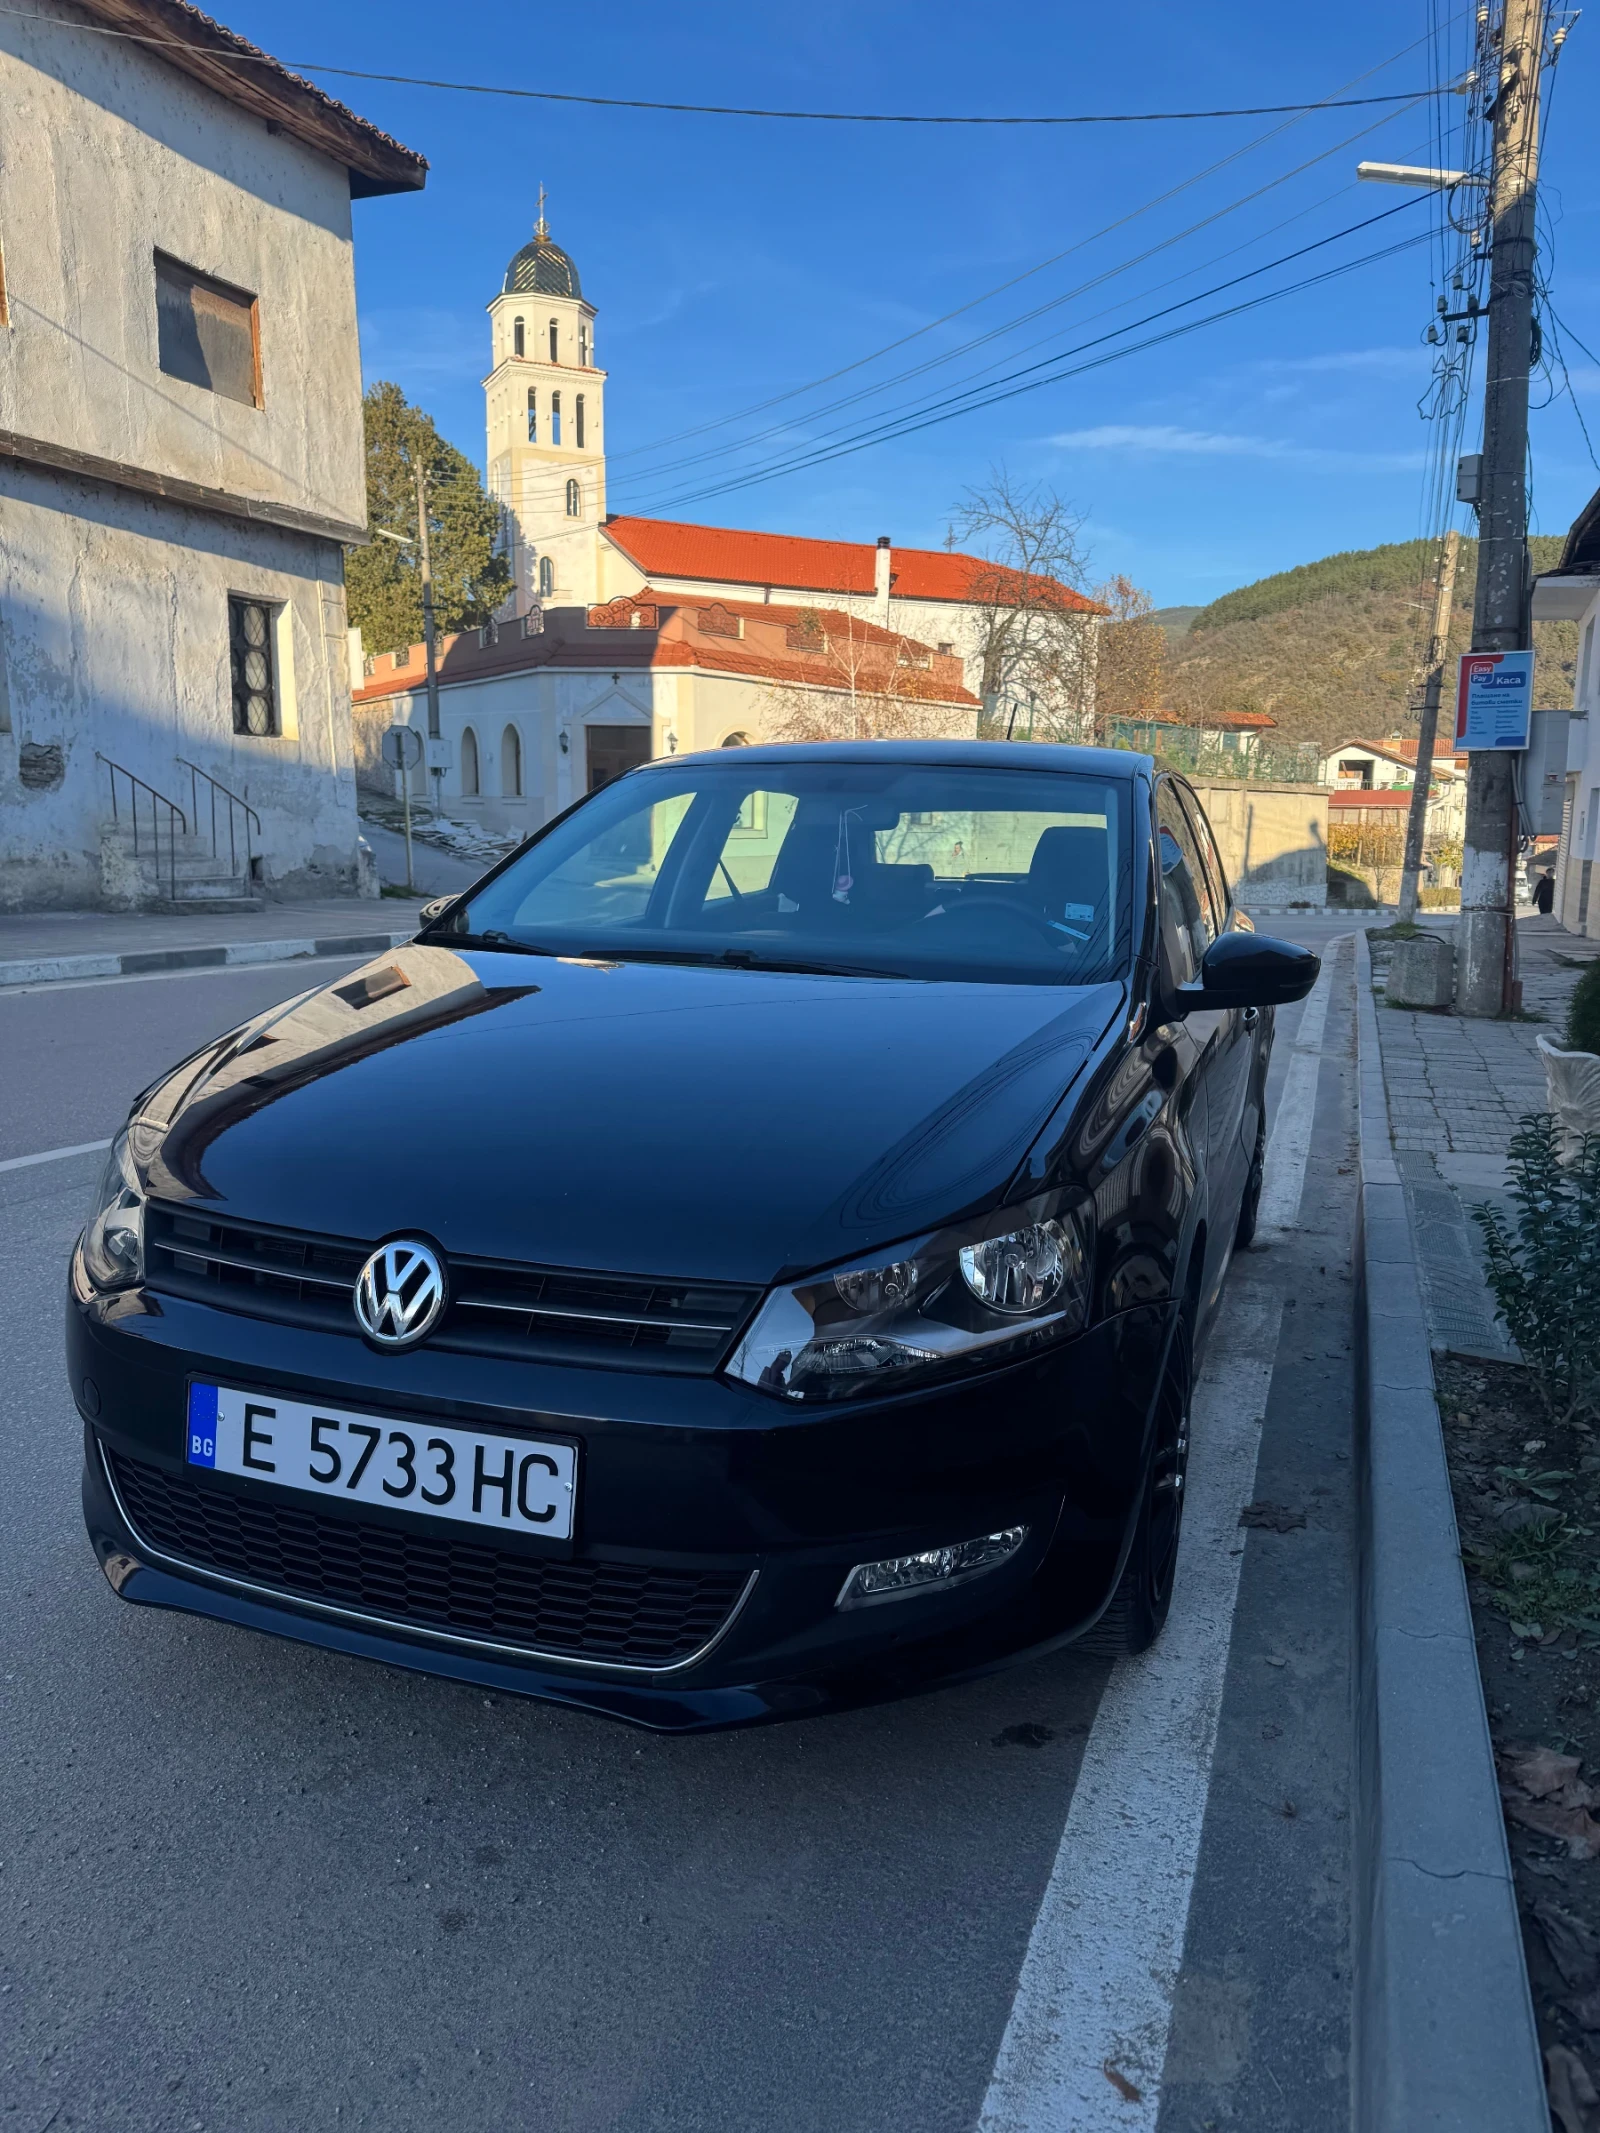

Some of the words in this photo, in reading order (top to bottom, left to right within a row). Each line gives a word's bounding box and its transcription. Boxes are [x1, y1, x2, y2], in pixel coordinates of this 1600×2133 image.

[1474, 665, 1492, 673] Easy
[1496, 676, 1521, 685] Каса
[191, 1434, 213, 1457] BG
[309, 1416, 456, 1506] 5733
